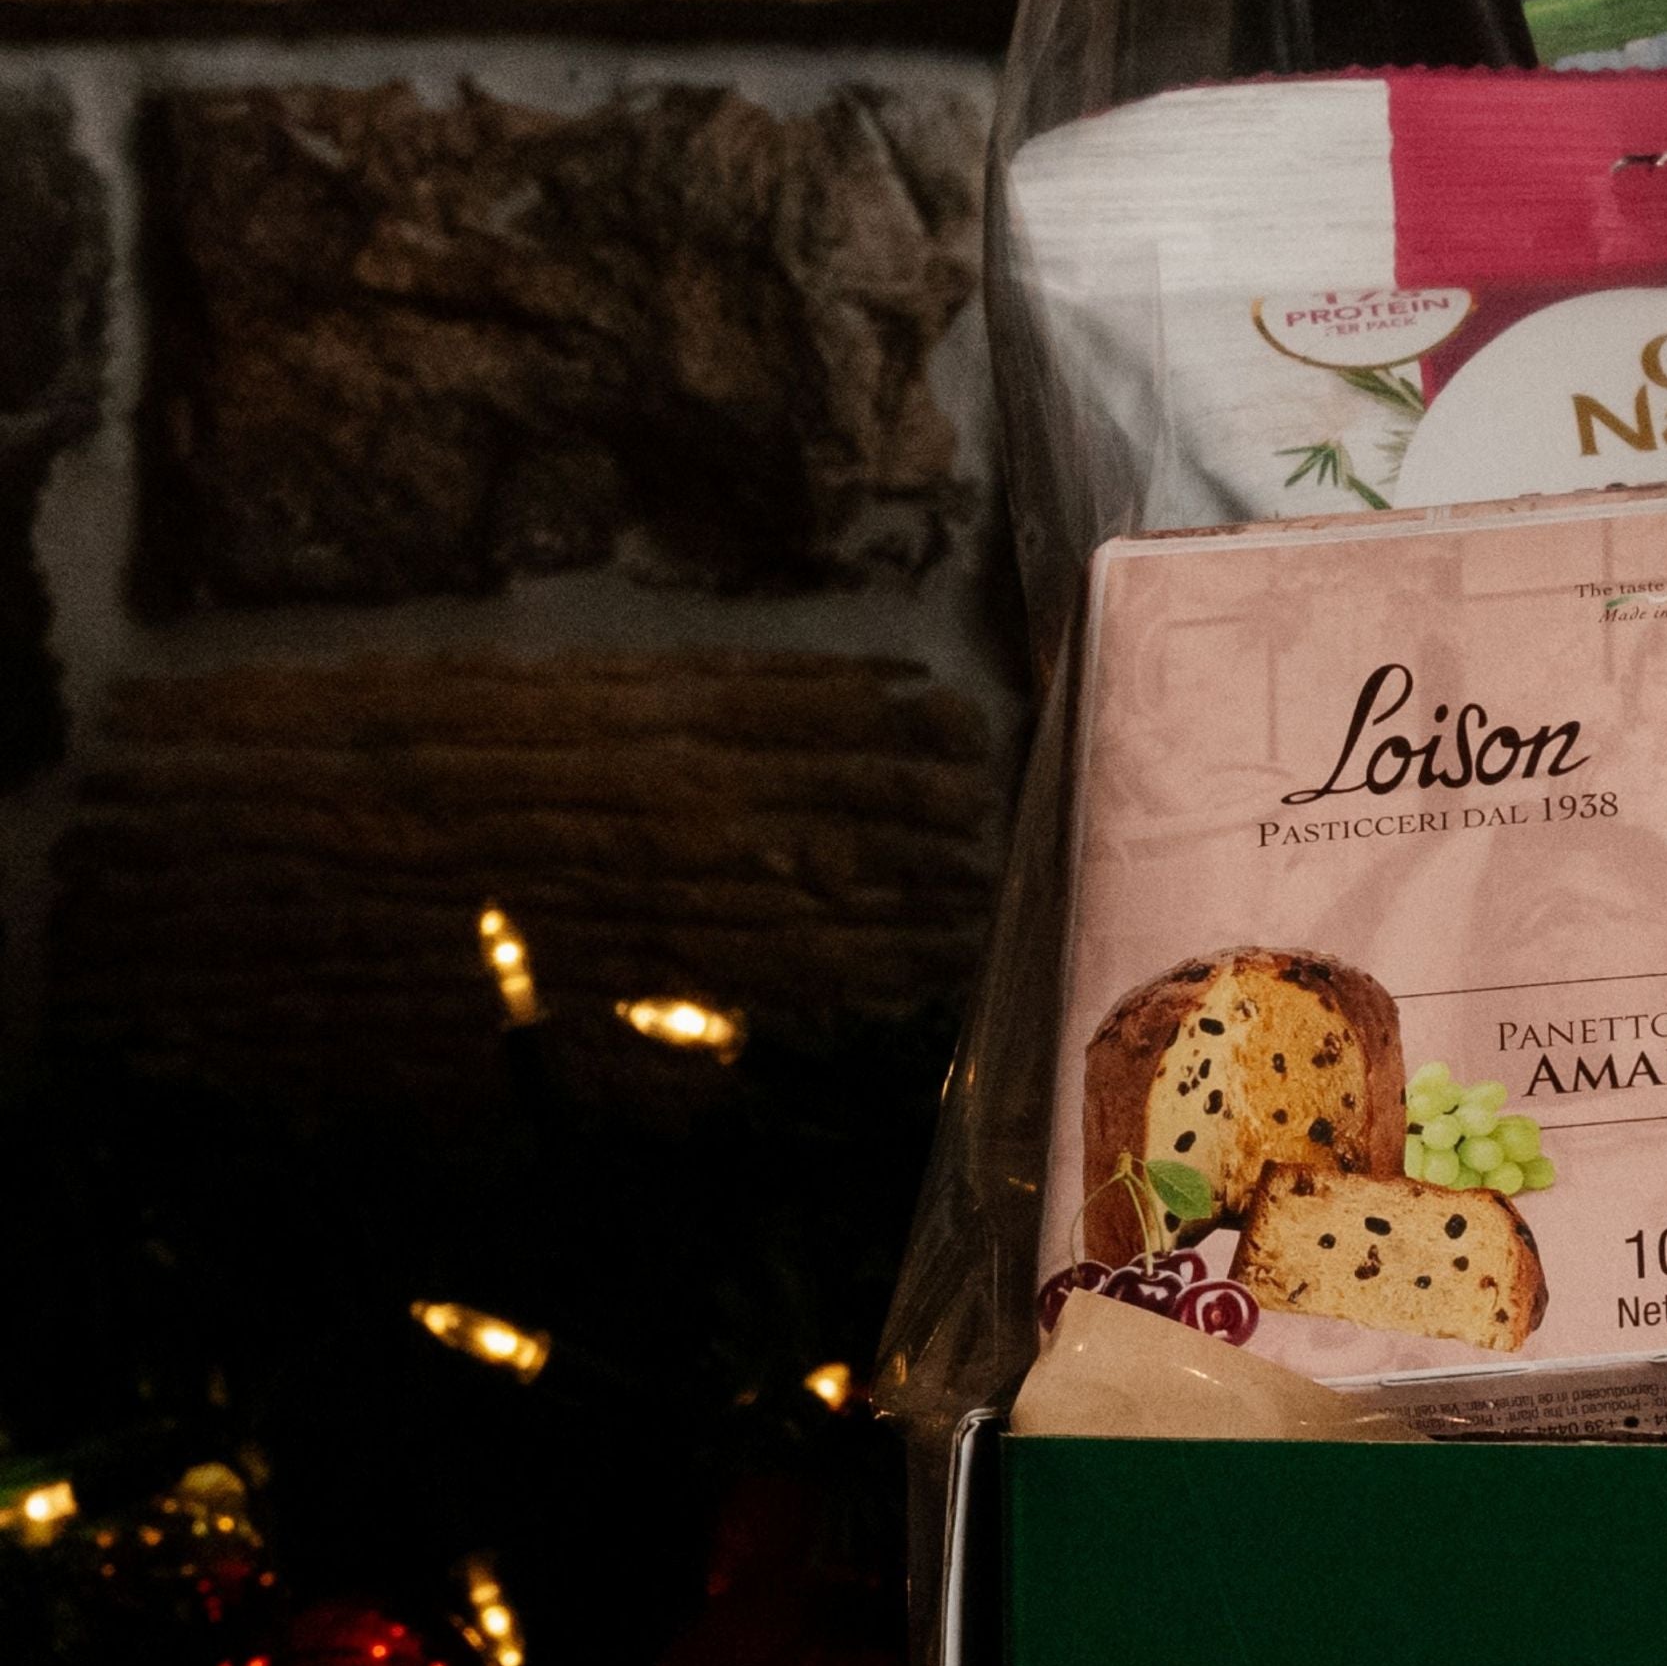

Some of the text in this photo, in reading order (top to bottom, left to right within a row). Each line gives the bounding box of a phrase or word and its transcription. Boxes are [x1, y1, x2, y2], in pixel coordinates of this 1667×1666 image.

[1285, 296, 1451, 328] PROTEIN
[1365, 315, 1417, 333] PACK
[1574, 582, 1614, 598] The
[1620, 579, 1665, 595] taste
[1598, 605, 1647, 624] Made
[1280, 662, 1593, 806] Loison
[1256, 791, 1619, 848] PASTICCERI DAL 1938
